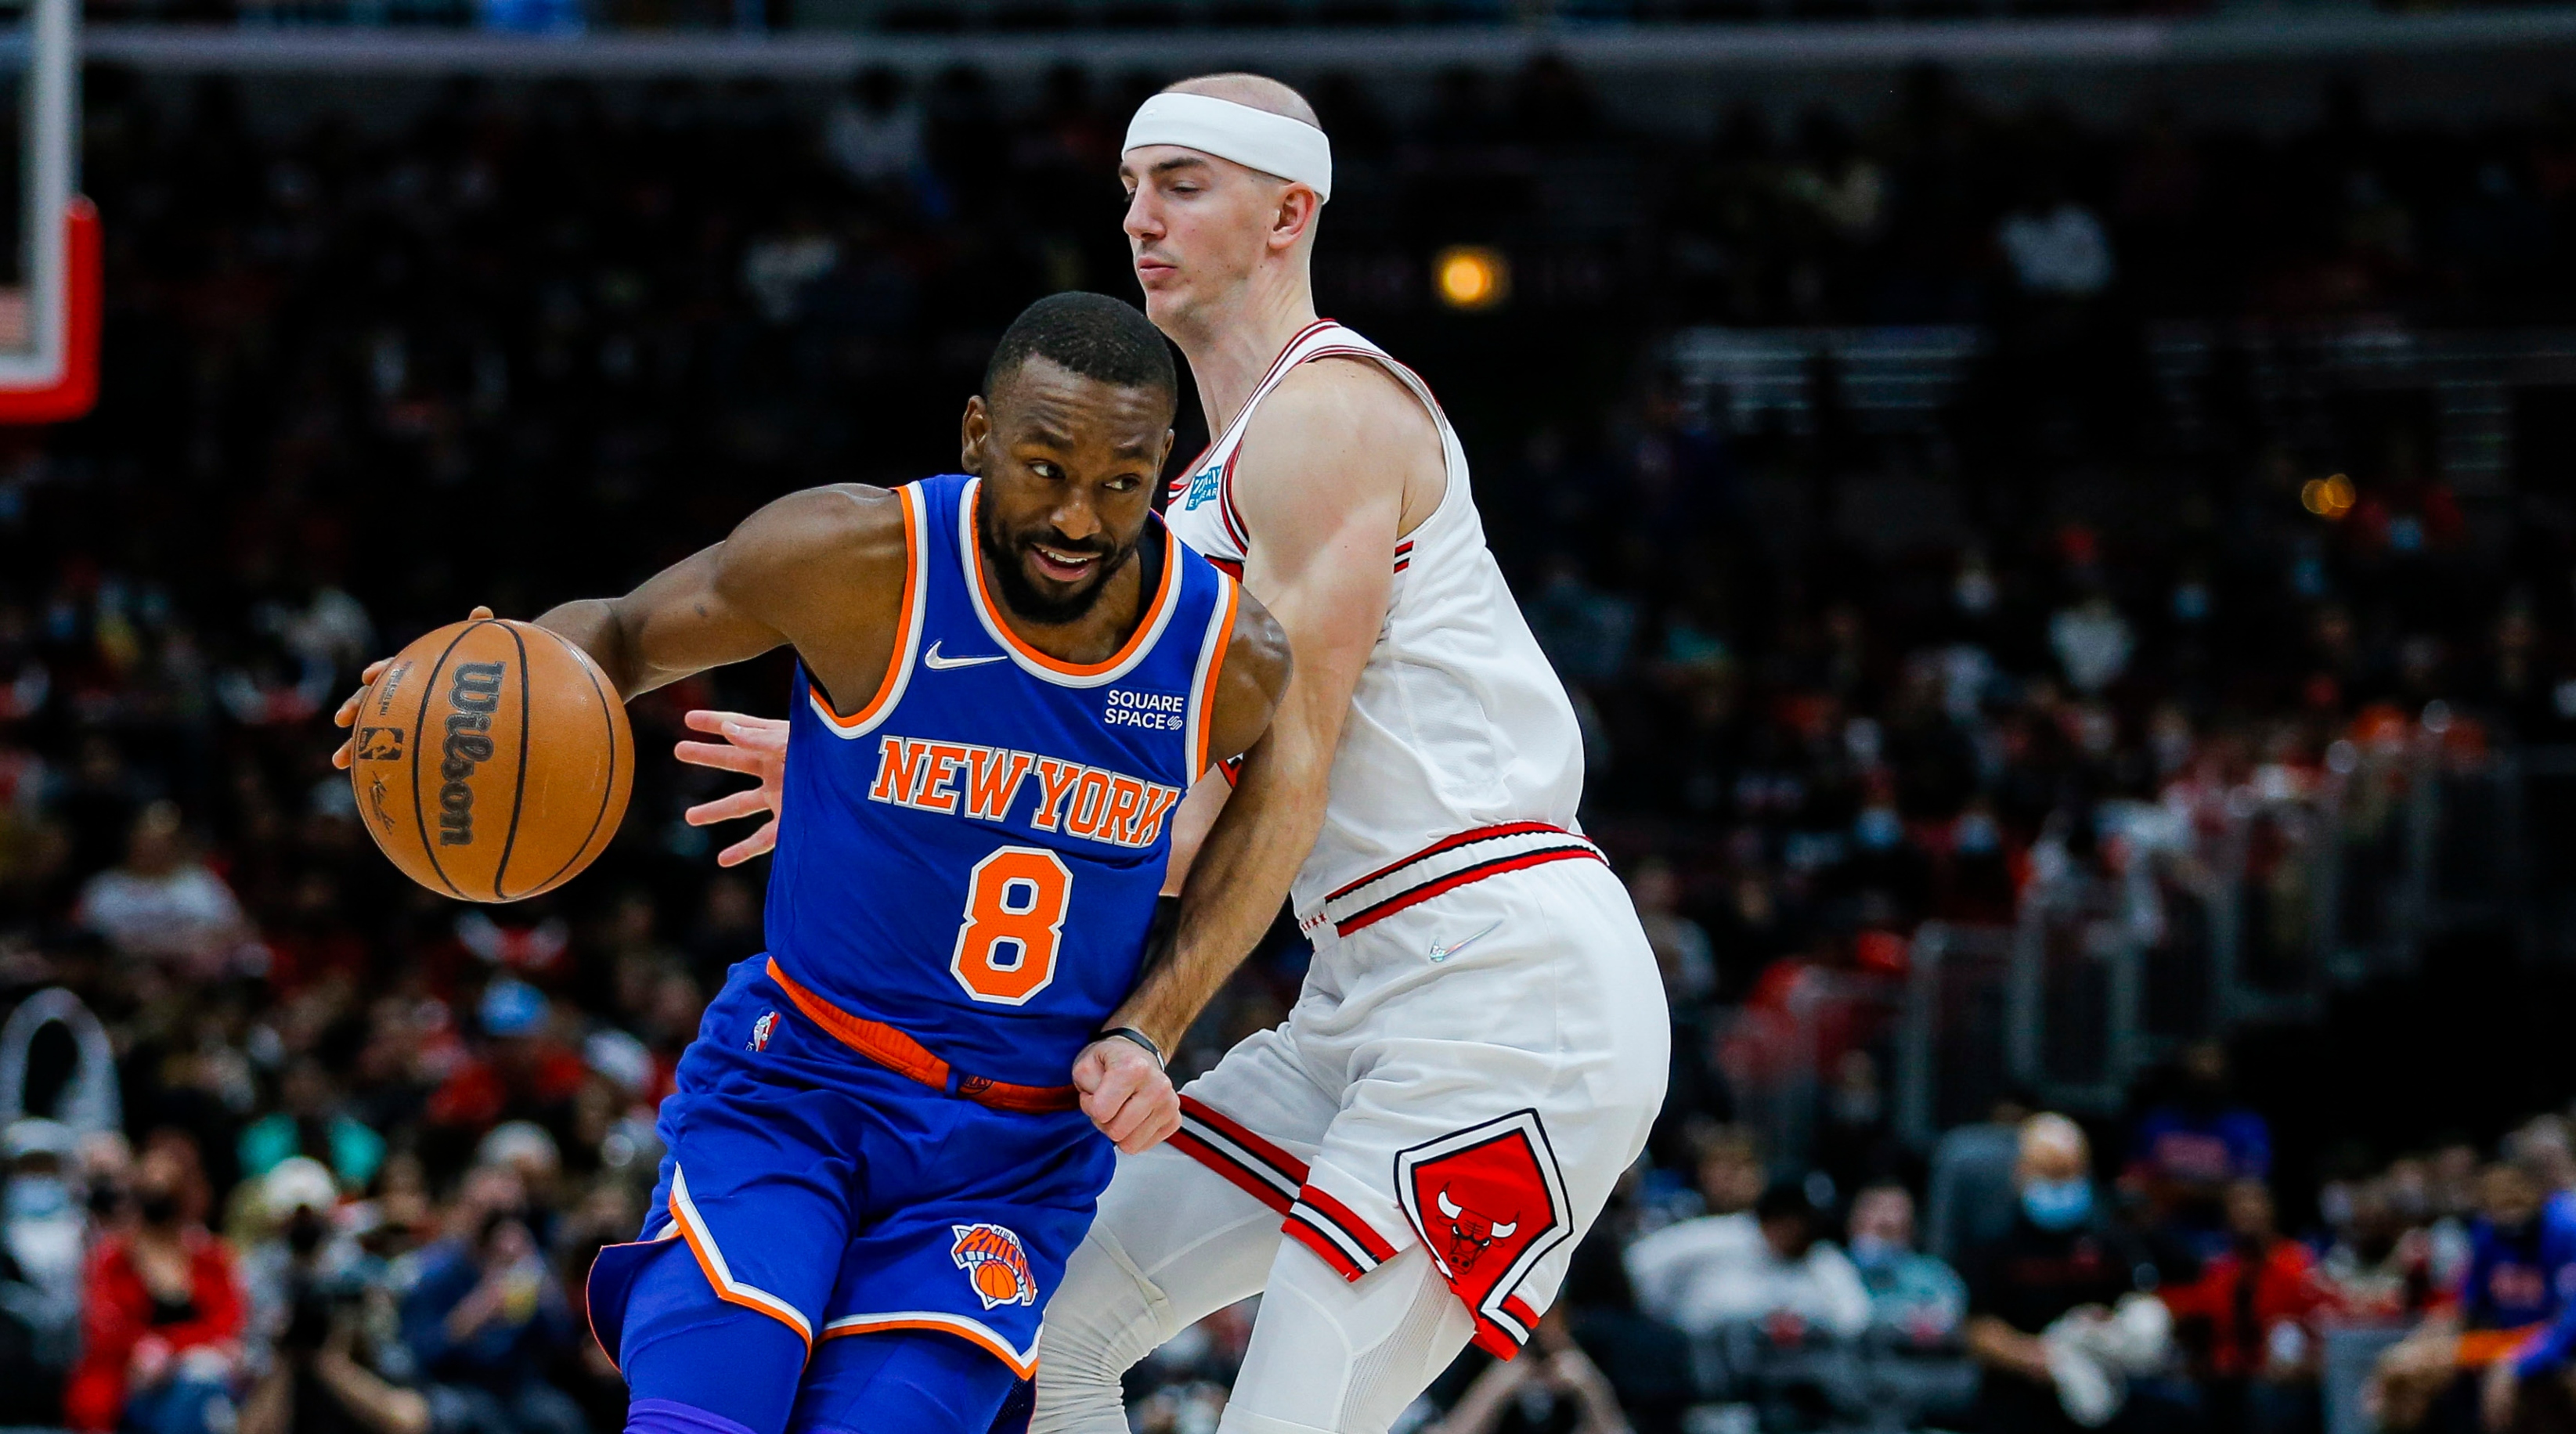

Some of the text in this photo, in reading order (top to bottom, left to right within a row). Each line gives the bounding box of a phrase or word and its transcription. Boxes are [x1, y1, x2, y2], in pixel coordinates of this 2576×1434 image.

[1104, 708, 1167, 730] SPACE
[1107, 690, 1184, 712] SQUARE
[439, 660, 507, 847] Wilson
[868, 735, 1181, 848] NEW YORK
[950, 845, 1073, 1006] 8
[994, 1227, 1011, 1238] NEW
